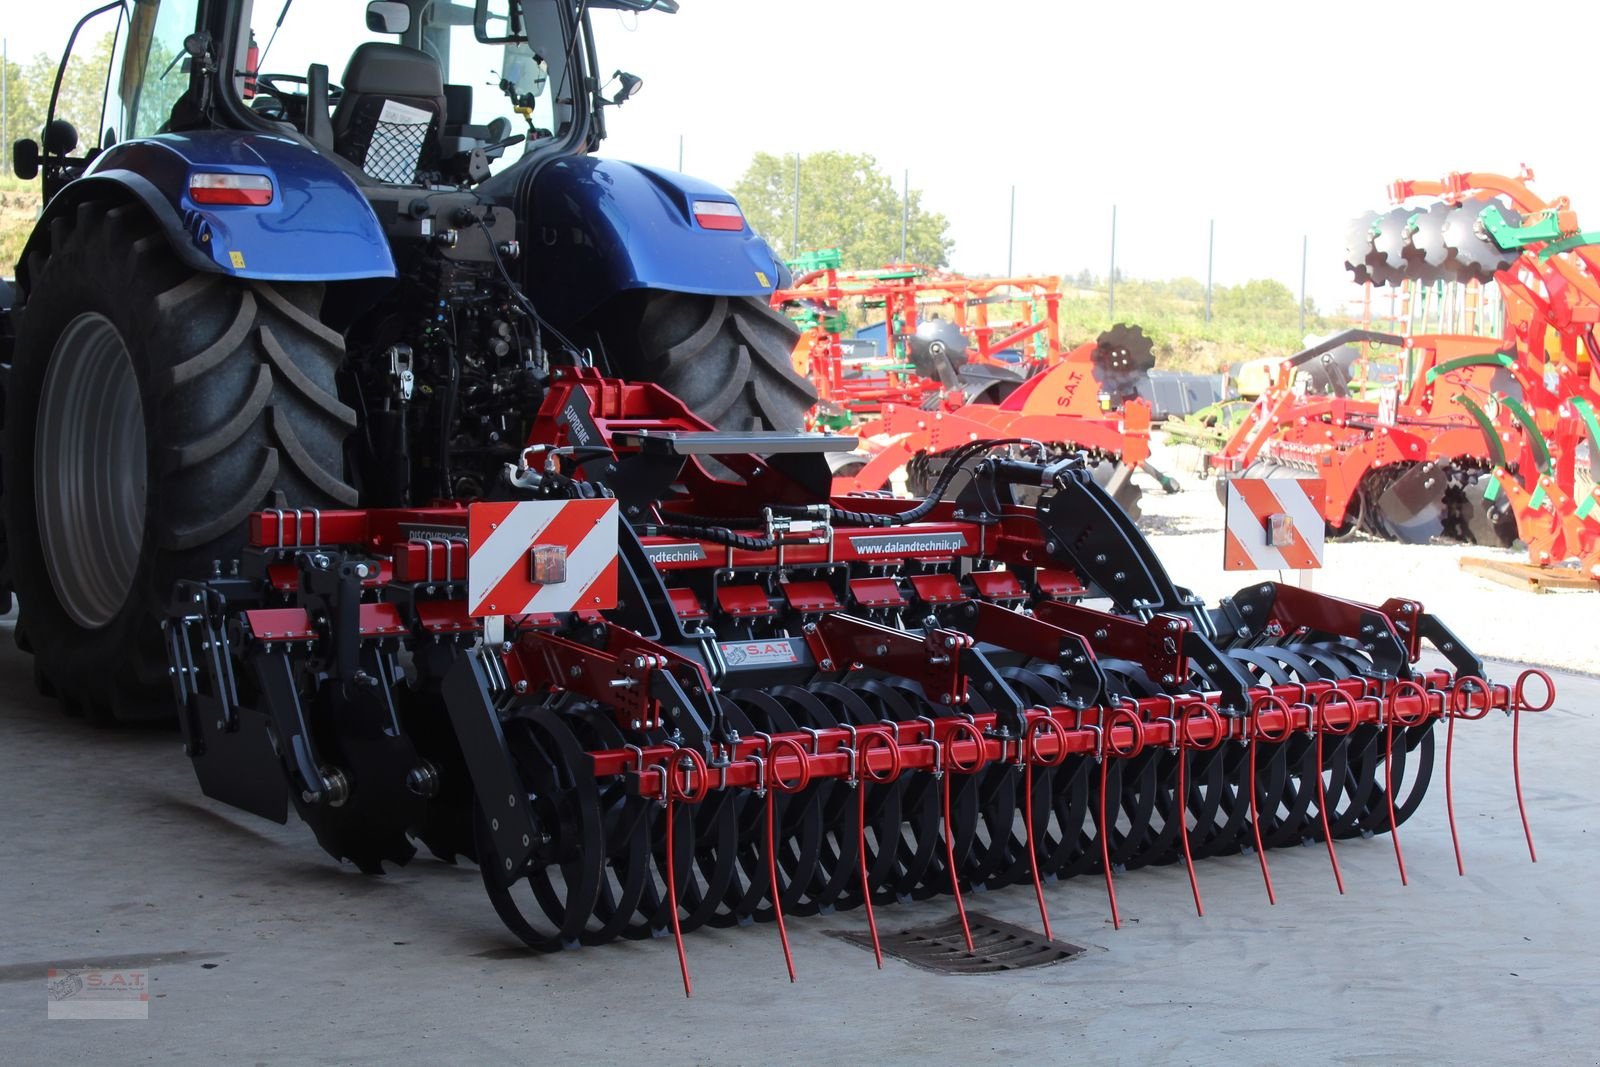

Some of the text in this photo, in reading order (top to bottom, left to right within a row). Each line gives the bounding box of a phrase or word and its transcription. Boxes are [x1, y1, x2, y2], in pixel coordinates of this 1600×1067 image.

[1057, 371, 1083, 407] S.A.T.
[565, 404, 590, 446] SUPREME
[857, 539, 961, 555] www.dalandtechnik.pl
[649, 550, 699, 563] ndtechnik
[746, 643, 791, 655] S.A.T.
